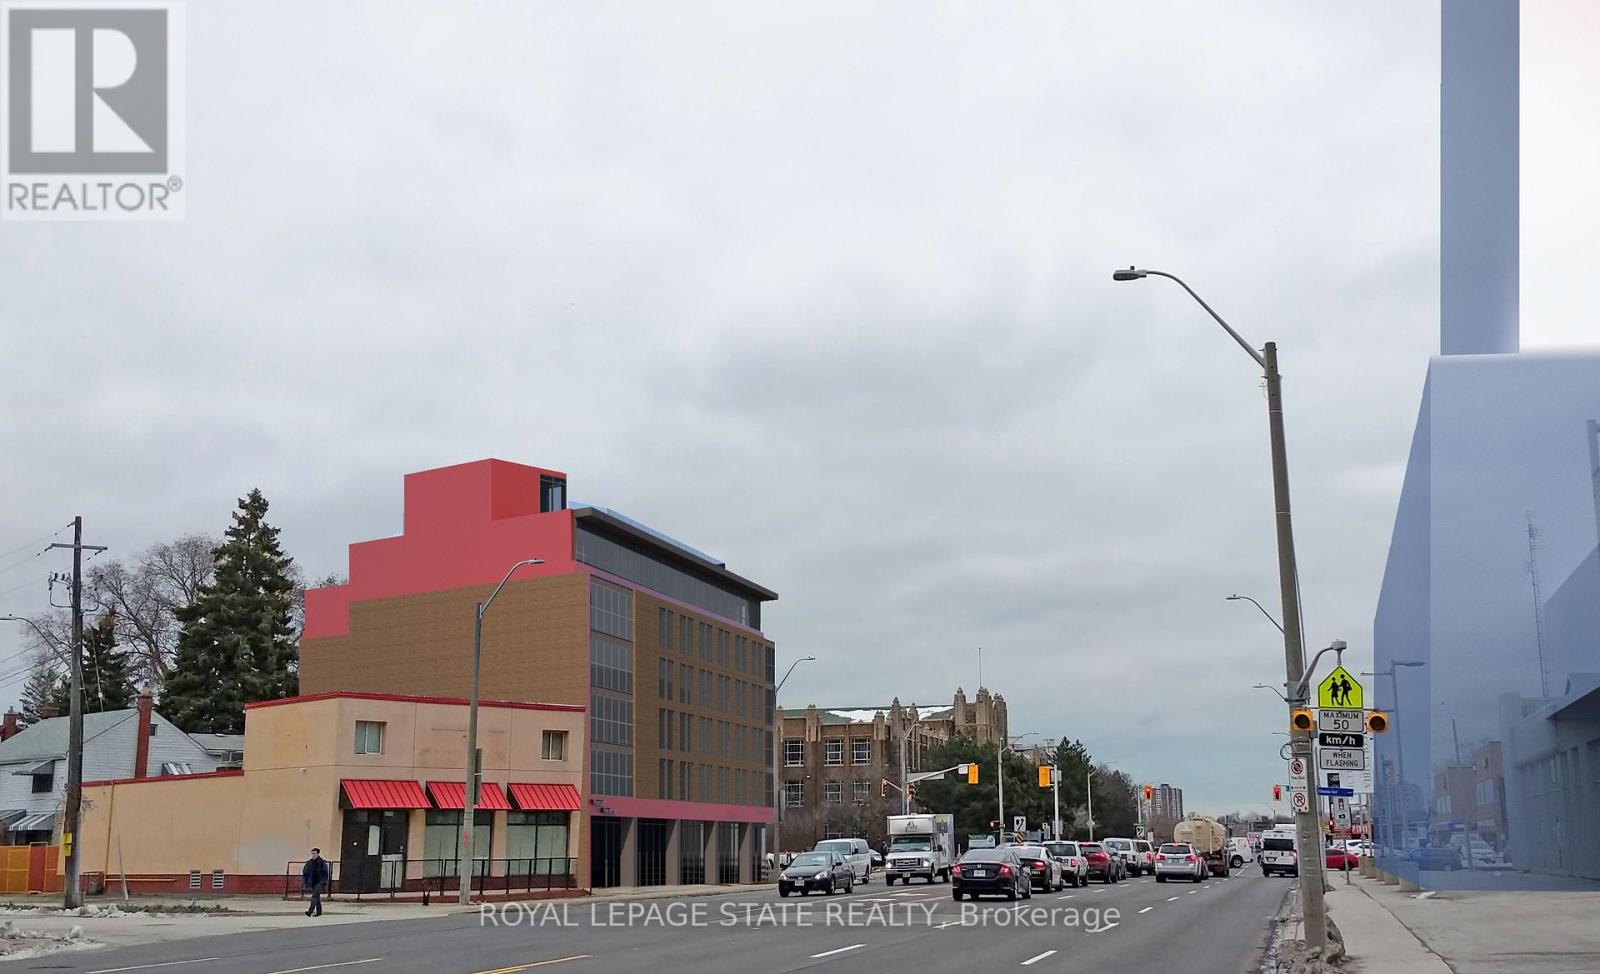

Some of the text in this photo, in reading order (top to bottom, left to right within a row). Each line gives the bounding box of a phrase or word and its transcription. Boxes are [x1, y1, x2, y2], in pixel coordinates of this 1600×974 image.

[1323, 711, 1359, 720] MAXIMUM
[1333, 719, 1350, 730] 50
[1325, 735, 1356, 745] km/h
[1332, 751, 1352, 759] WHEN
[1326, 759, 1359, 768] FLASHING
